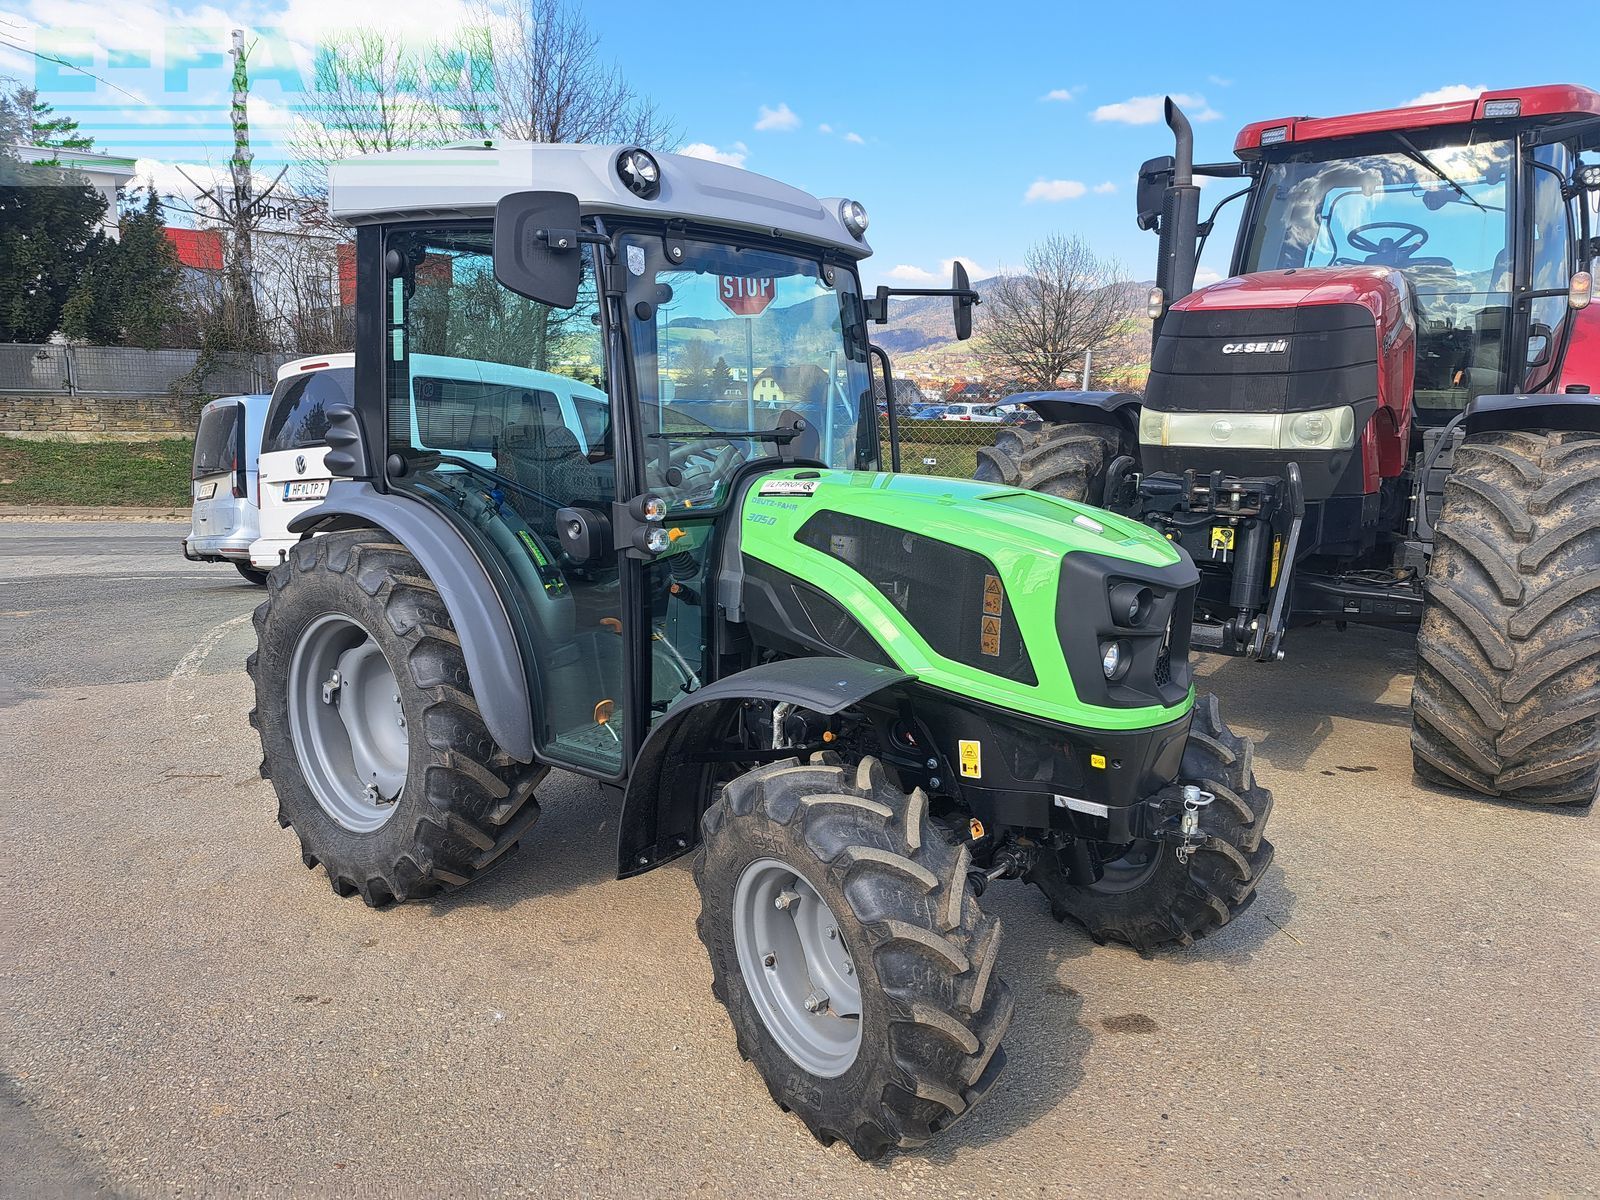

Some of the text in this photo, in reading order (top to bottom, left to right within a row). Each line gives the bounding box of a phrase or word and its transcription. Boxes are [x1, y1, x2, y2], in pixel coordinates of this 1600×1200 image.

[724, 276, 770, 298] STOP
[1222, 342, 1266, 354] CASE
[292, 485, 302, 496] HF
[305, 483, 319, 495] LTP
[751, 497, 798, 511] DEUTZ-FAHR
[746, 513, 777, 525] 3050
